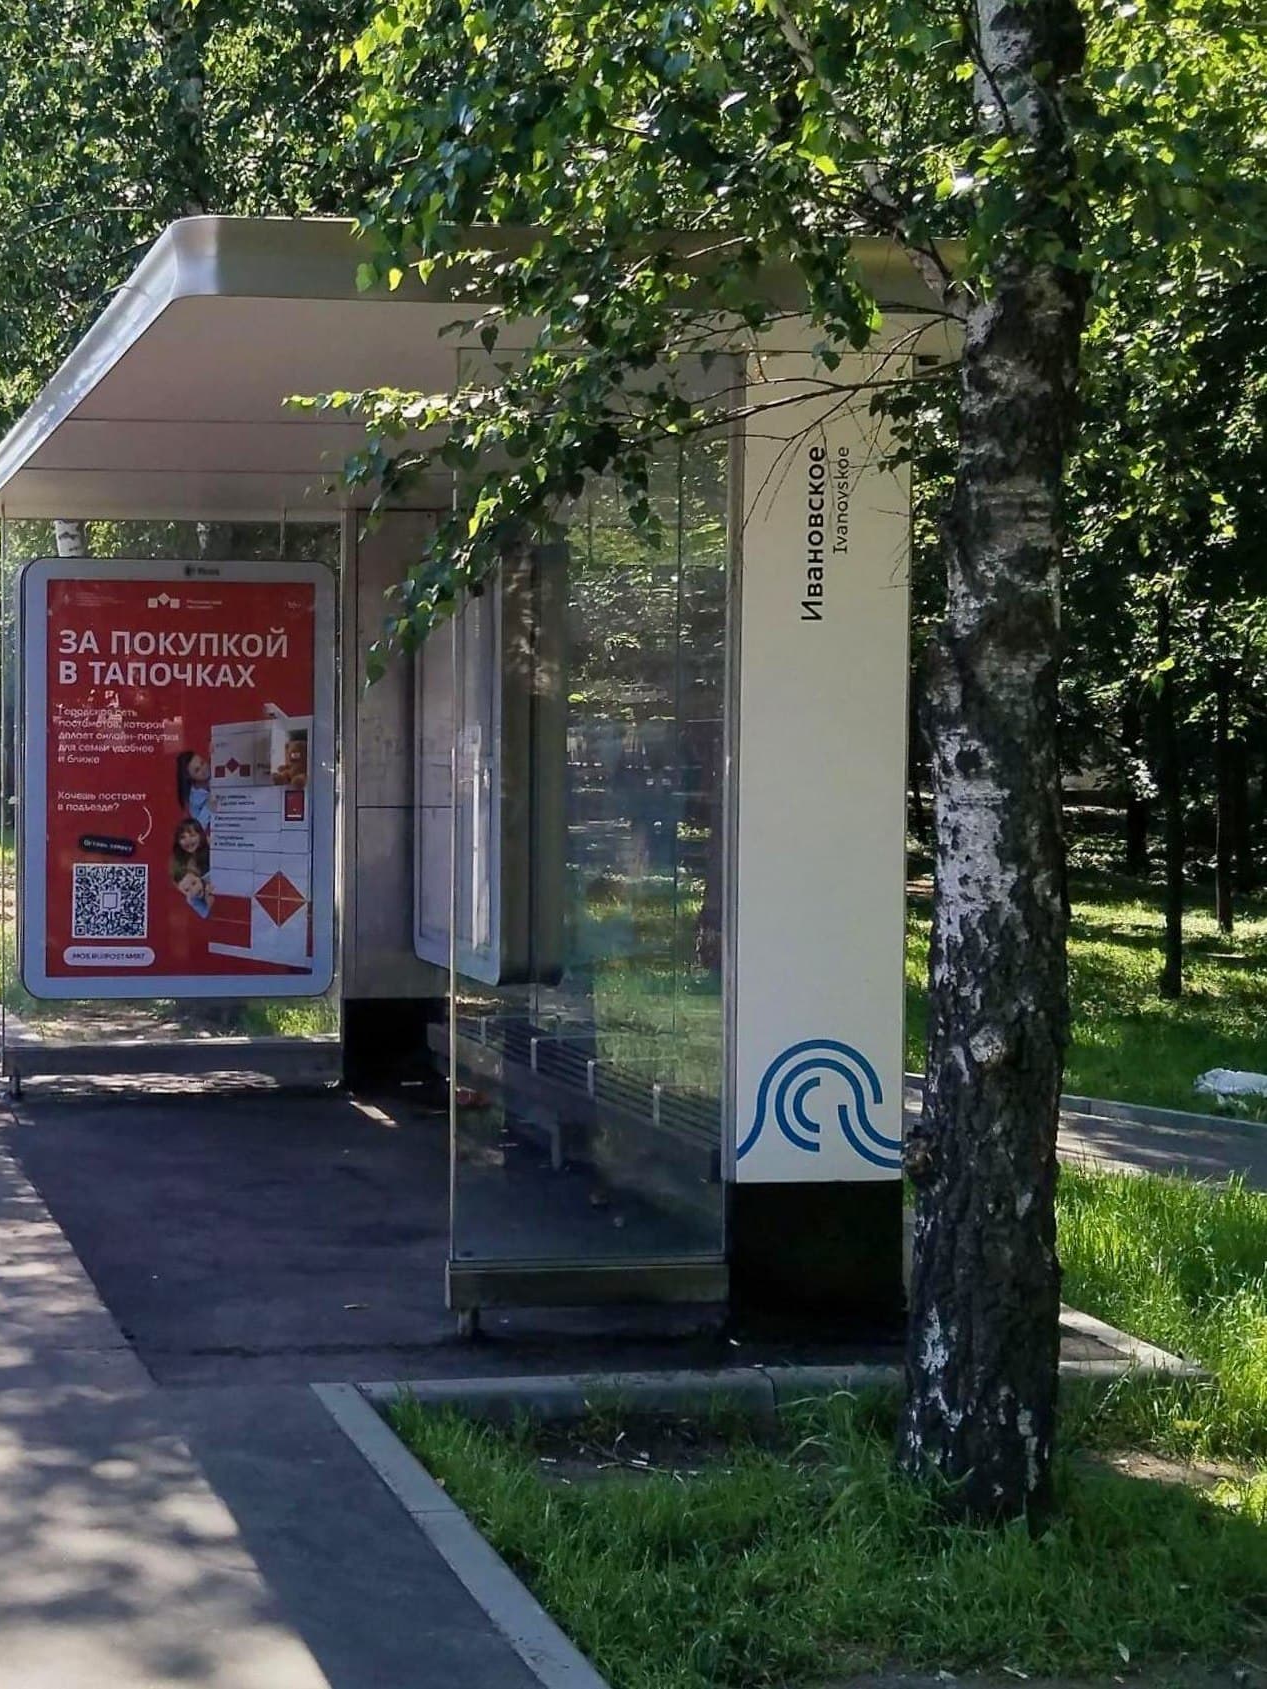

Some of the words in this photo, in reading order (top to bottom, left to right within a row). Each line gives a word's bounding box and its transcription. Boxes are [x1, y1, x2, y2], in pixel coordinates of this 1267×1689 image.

[833, 446, 850, 554] Ivanovskoe
[800, 446, 825, 620] Ивановское
[58, 630, 100, 654] ЗА
[110, 627, 288, 658] ПОКУПКОЙ
[59, 660, 78, 684] В
[88, 662, 255, 688] ТАПОЧКАХ
[58, 744, 76, 752] для
[57, 791, 97, 800] Хочешь
[98, 793, 147, 801] постамат
[65, 802, 120, 812] подъезде?
